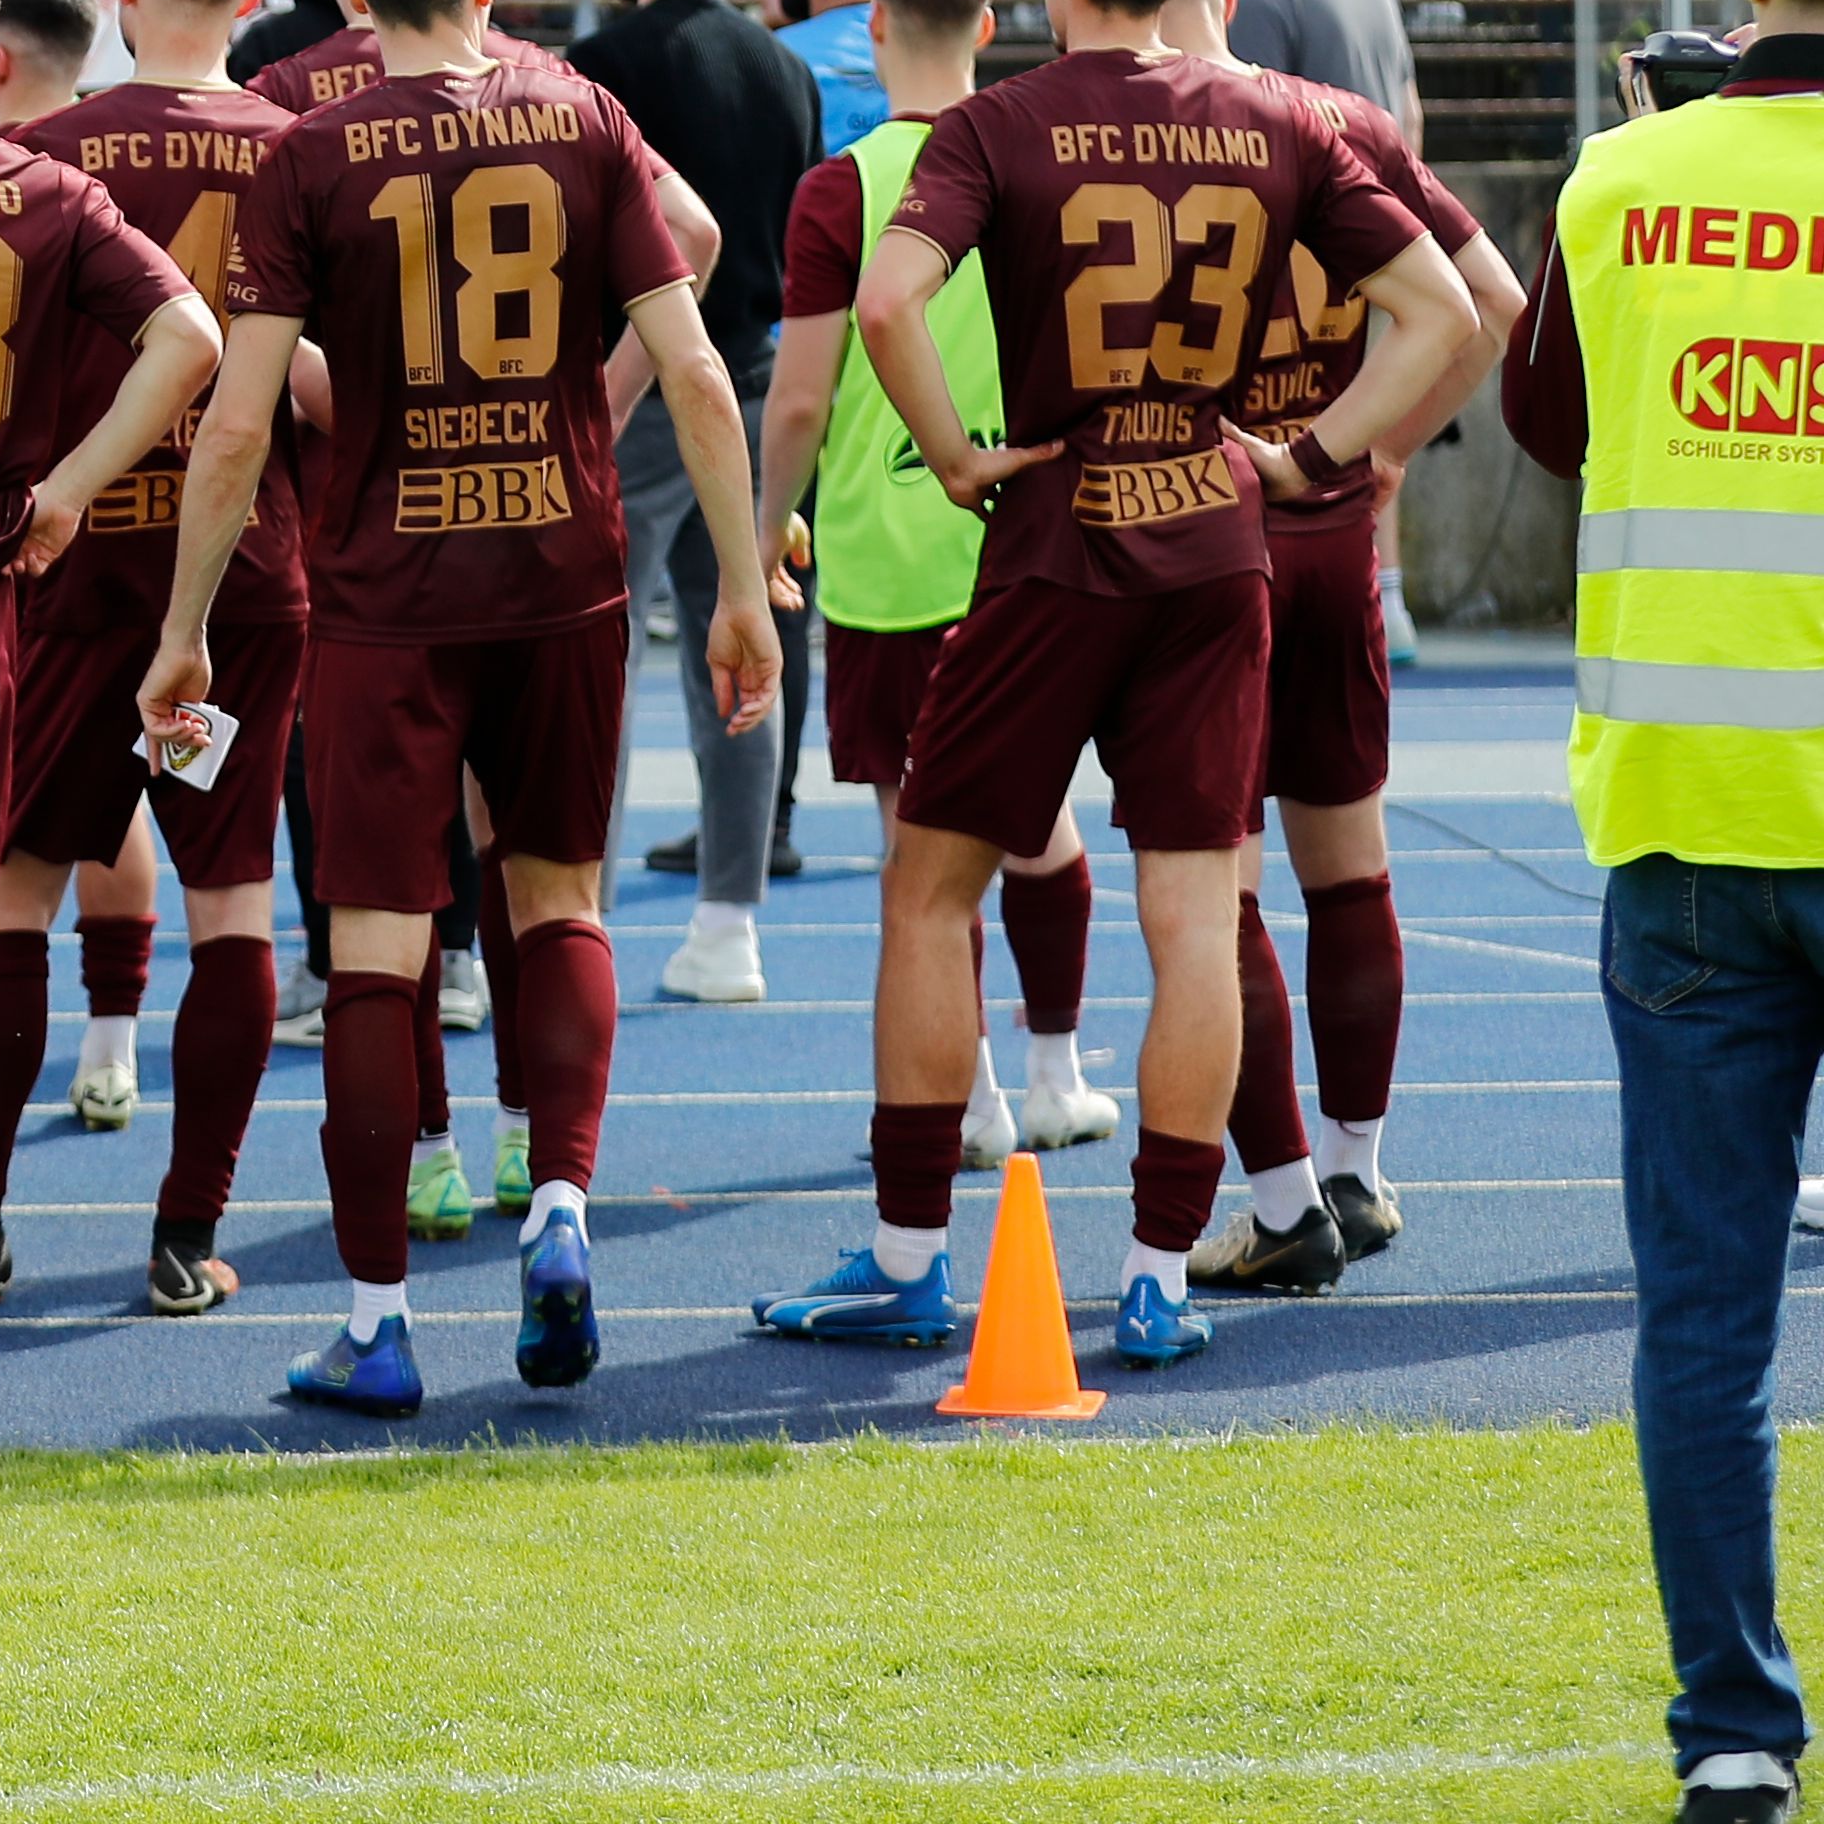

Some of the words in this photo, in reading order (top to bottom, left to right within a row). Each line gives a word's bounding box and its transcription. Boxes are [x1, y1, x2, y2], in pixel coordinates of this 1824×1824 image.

[80, 133, 151, 173] BFC
[345, 116, 422, 163] BFC
[433, 103, 580, 152] DYNAMO
[1052, 123, 1124, 163] BFC
[1133, 123, 1270, 168] DYNAMO
[368, 163, 566, 386] 18
[1061, 182, 1269, 389] 23
[409, 366, 432, 381] BFC
[499, 359, 523, 374] BFC
[405, 401, 550, 450] SIEBECK
[1667, 439, 1771, 461] SCHILDER
[448, 456, 570, 527] BBK
[1110, 458, 1238, 520] BBK
